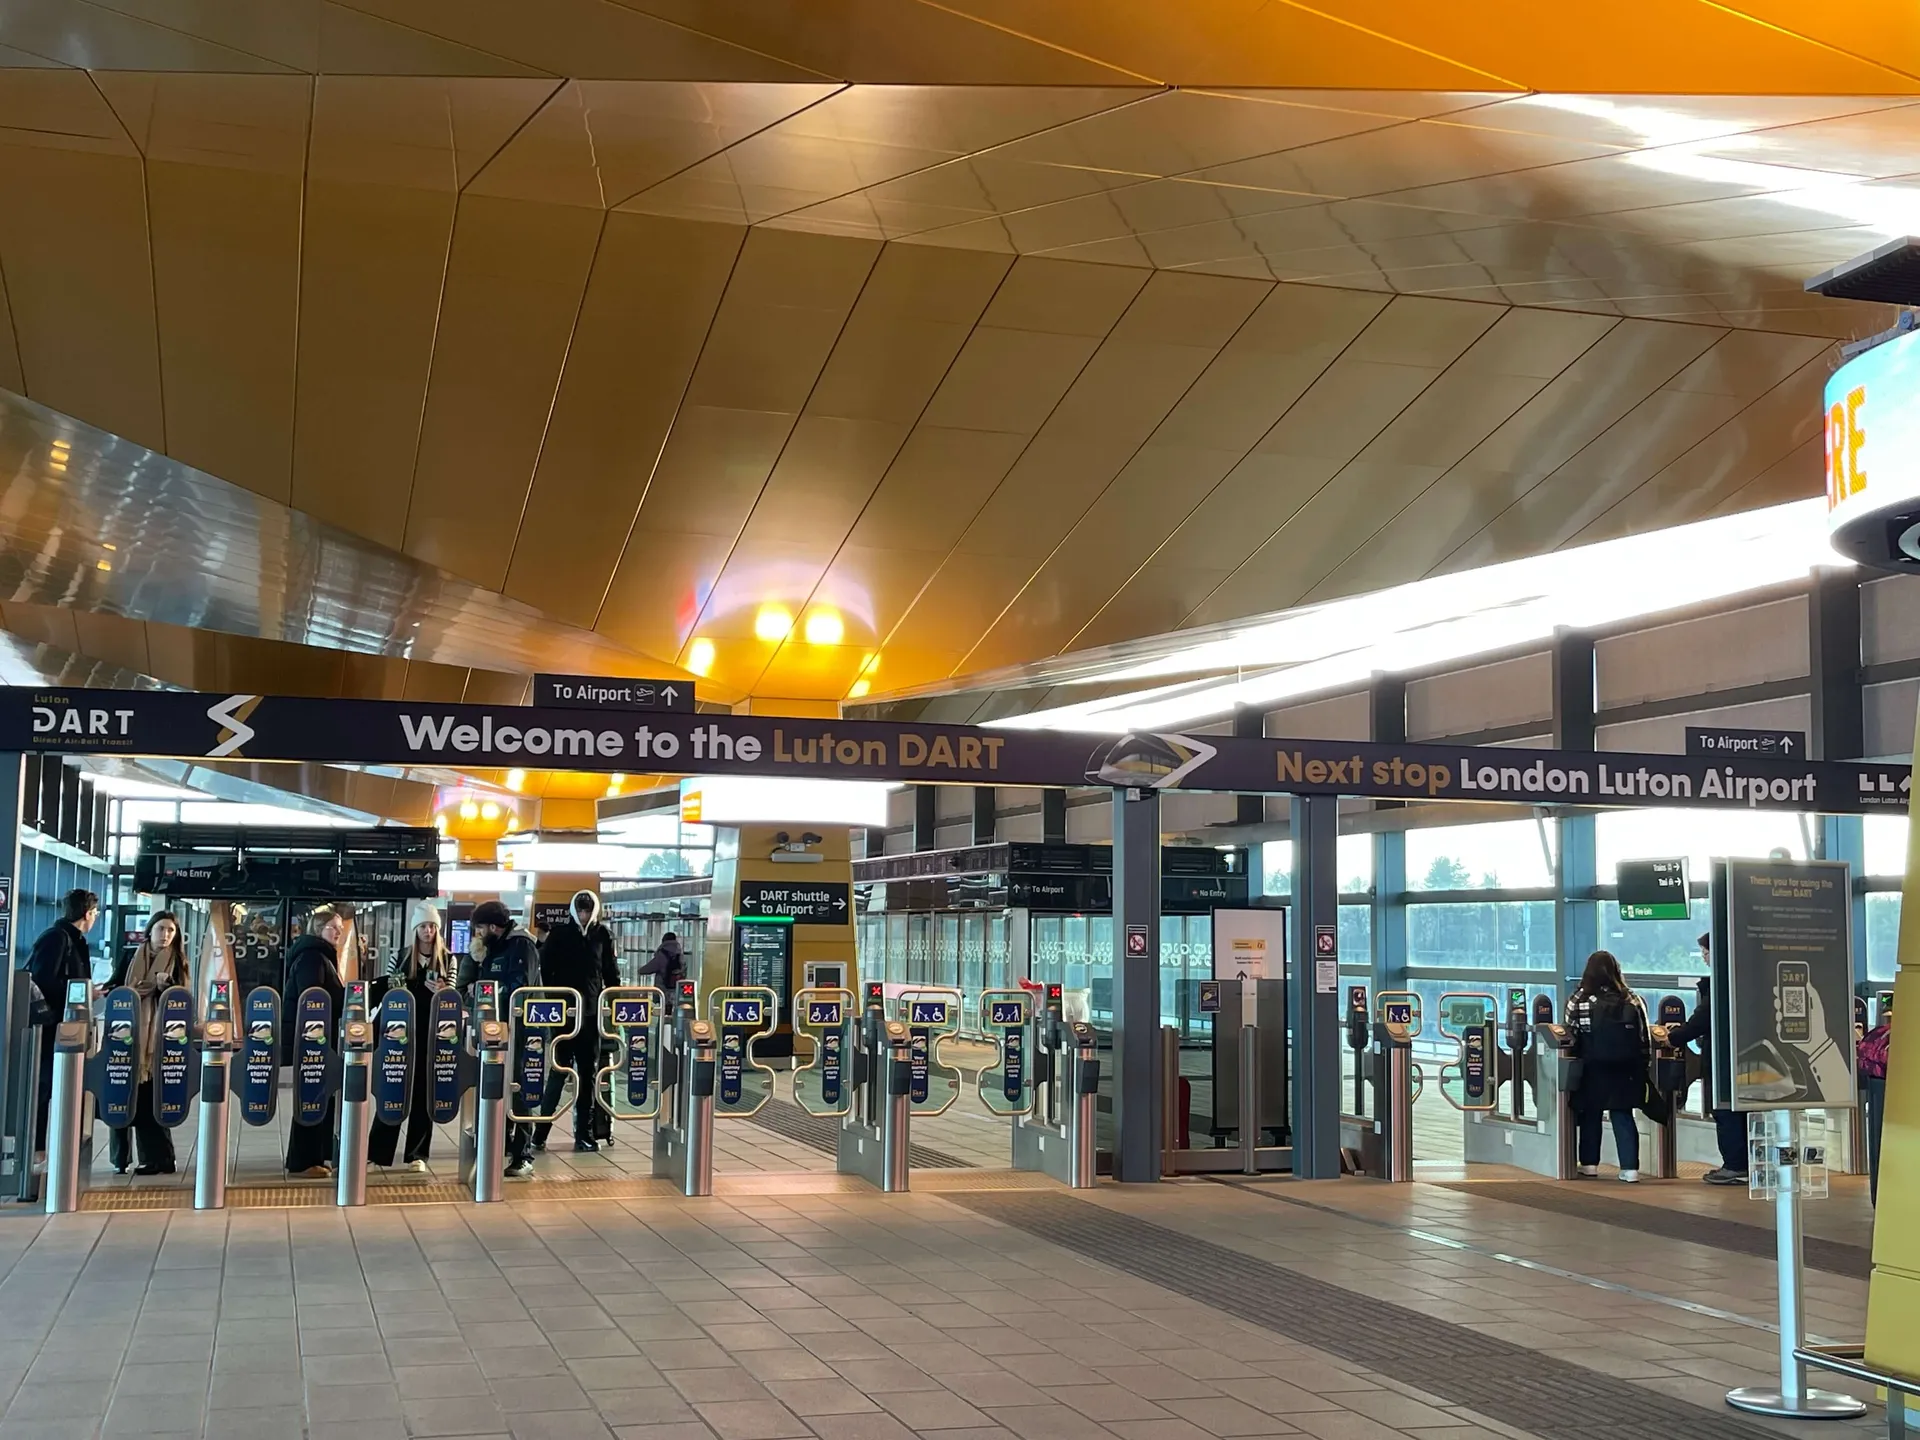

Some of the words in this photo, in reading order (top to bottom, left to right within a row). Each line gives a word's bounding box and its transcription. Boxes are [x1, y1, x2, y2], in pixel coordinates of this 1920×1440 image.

[34, 694, 70, 704] Luton
[553, 684, 572, 699] To
[576, 684, 631, 704] Airport
[32, 706, 135, 735] DART
[33, 736, 61, 744] Direct
[399, 714, 624, 757] Welcome
[634, 725, 680, 758] to
[689, 724, 762, 762] the
[773, 729, 887, 766] Luton
[898, 734, 1005, 770] DART
[1699, 735, 1715, 748] To
[1717, 736, 1758, 753] Airport
[1276, 751, 1364, 784] Next
[1372, 756, 1451, 795] stop
[1460, 758, 1589, 794] London
[1598, 764, 1692, 798] Luton
[1699, 767, 1817, 807] Airport
[1860, 796, 1880, 804] London
[176, 869, 188, 877] No
[189, 869, 211, 879] Entry
[383, 873, 410, 883] Airport
[1750, 876, 1772, 885] Thank
[1773, 878, 1787, 887] you
[1800, 880, 1820, 890] using
[1042, 886, 1064, 894] Airport
[1210, 890, 1226, 898] Entry
[1793, 889, 1812, 897] DART
[760, 890, 789, 901] DART
[791, 890, 830, 902] shuttle
[761, 904, 773, 914] to
[775, 903, 813, 916] Airport
[1782, 973, 1805, 982] DART
[107, 1063, 132, 1071] journey
[247, 1063, 272, 1071] journey
[382, 1062, 407, 1070] journey
[434, 1062, 457, 1070] journey
